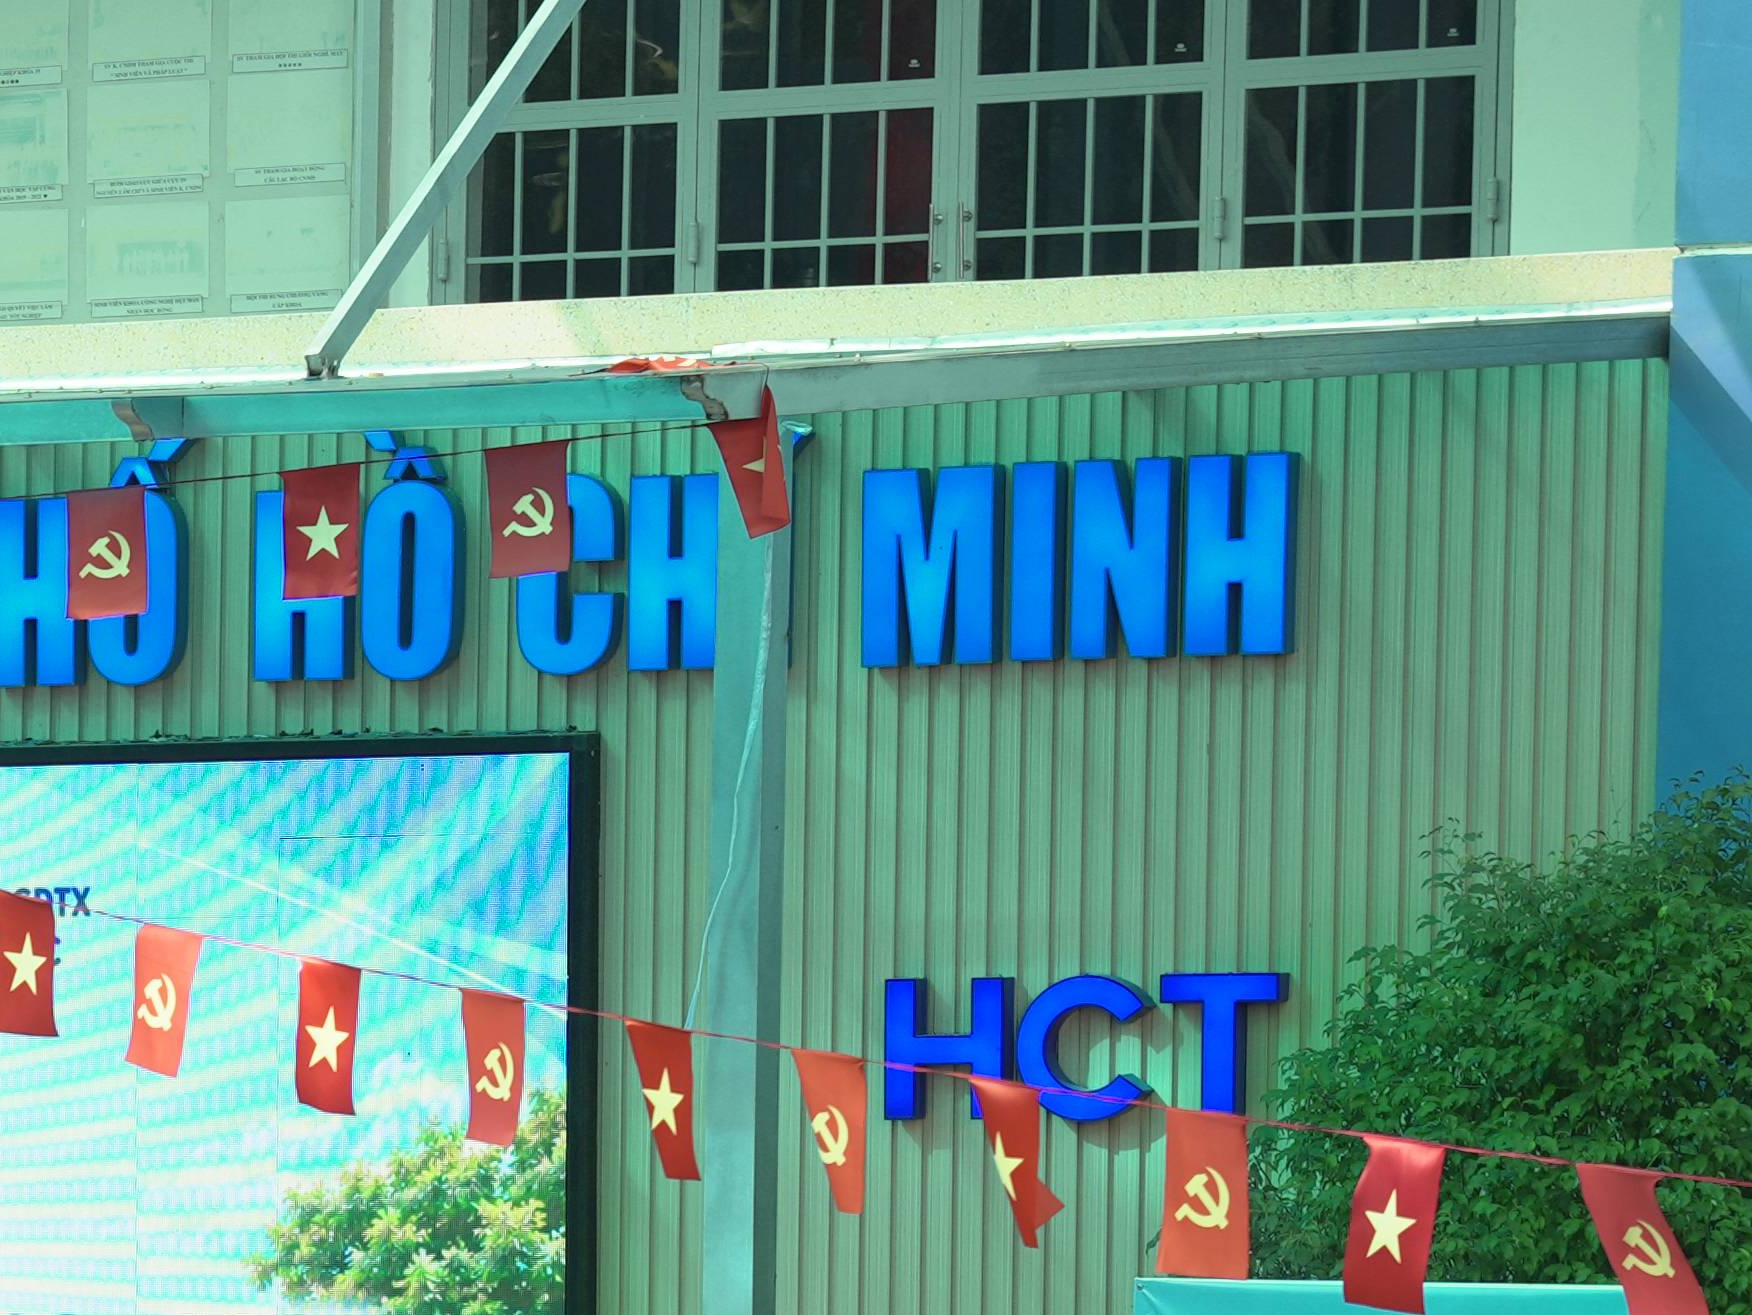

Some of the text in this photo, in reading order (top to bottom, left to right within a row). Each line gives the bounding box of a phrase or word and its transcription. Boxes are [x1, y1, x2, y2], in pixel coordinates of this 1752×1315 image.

[254, 430, 466, 681] HỒ
[516, 435, 792, 675] CH
[862, 451, 1299, 671] MINH
[884, 972, 1290, 1124] HCT
